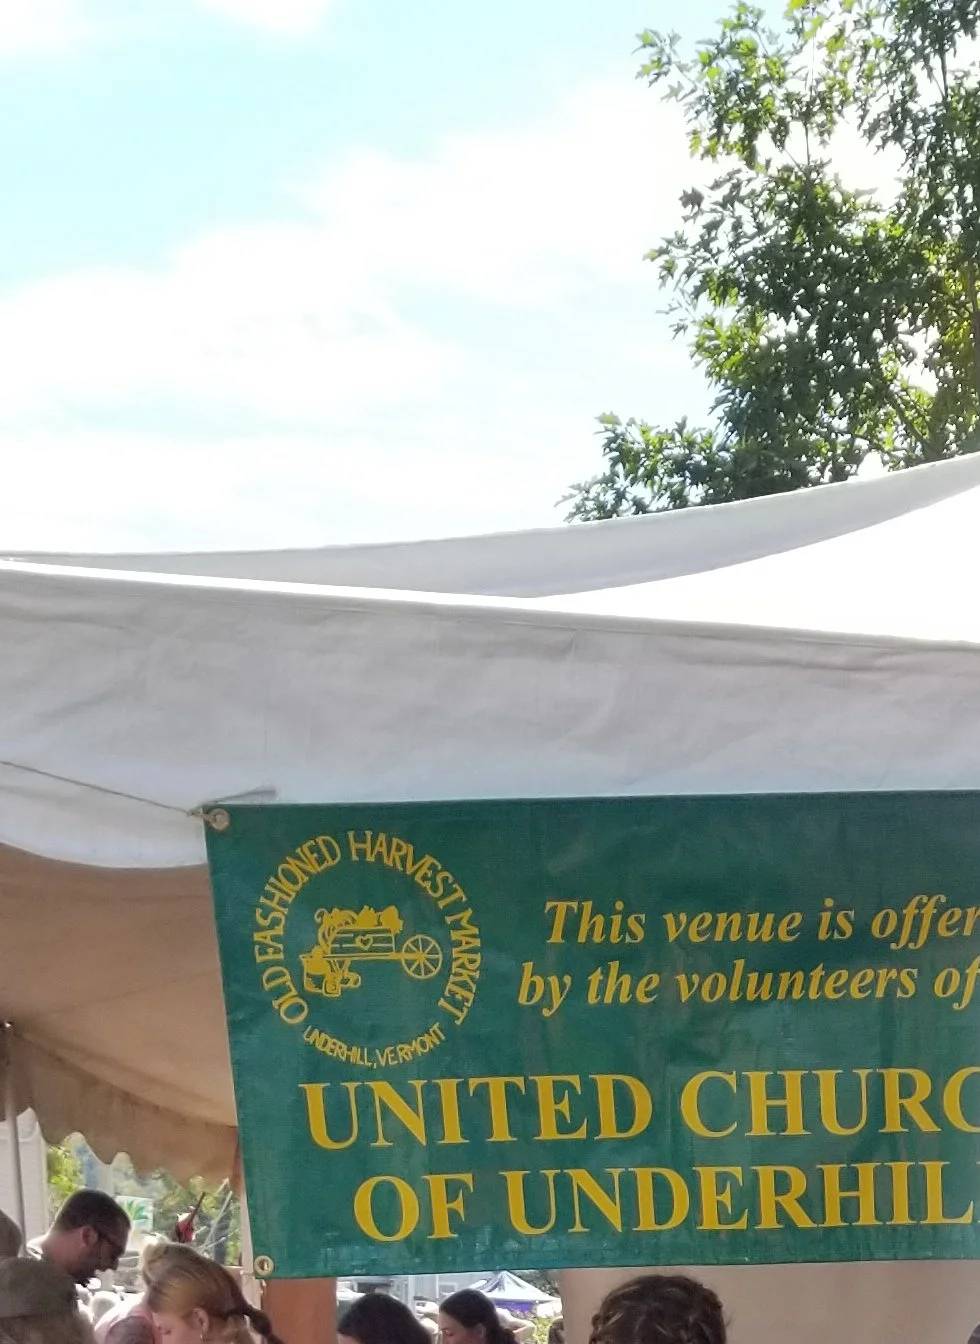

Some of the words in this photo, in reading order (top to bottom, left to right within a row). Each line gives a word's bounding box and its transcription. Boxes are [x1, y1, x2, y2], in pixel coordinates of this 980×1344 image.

[253, 835, 342, 963] FASHIONED
[347, 830, 467, 910] HARVEST
[544, 899, 646, 944] This
[663, 907, 802, 943] venue
[817, 897, 855, 940] is
[262, 965, 309, 1025] OLD
[438, 907, 482, 1026] MARKET
[517, 961, 572, 1017] by
[586, 959, 659, 1005] the
[674, 959, 919, 1002] volunteers
[375, 1021, 446, 1067] VERMONT
[299, 1074, 653, 1150] UNITED
[353, 1172, 474, 1243] OF
